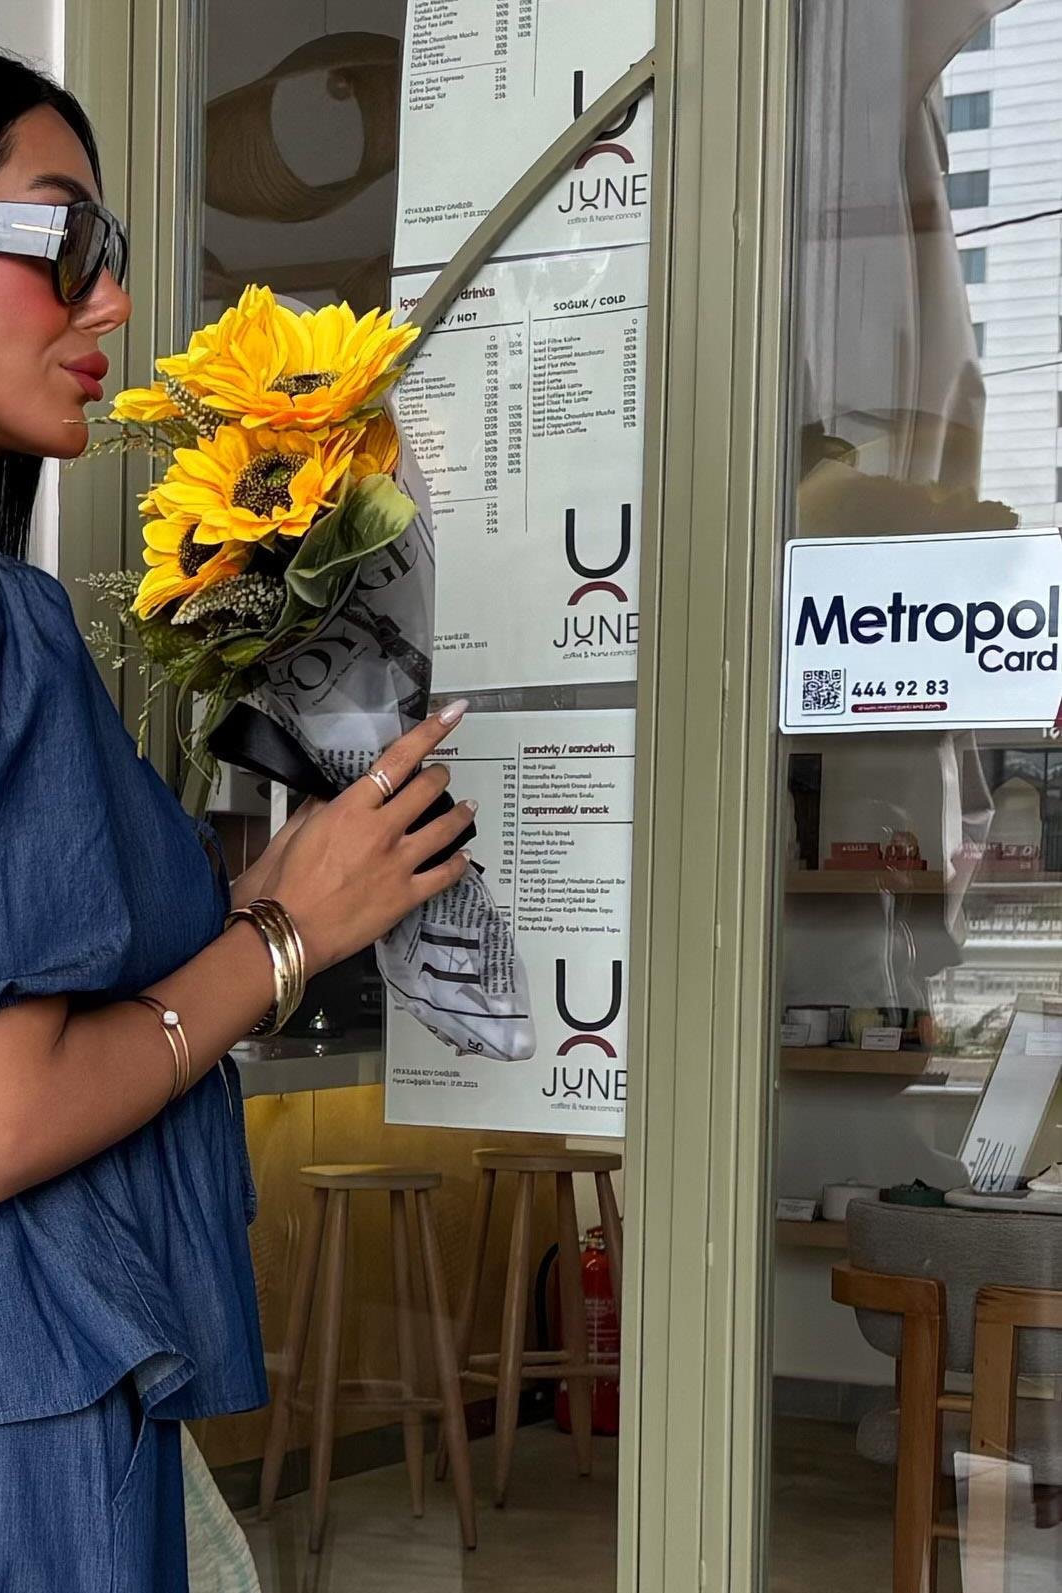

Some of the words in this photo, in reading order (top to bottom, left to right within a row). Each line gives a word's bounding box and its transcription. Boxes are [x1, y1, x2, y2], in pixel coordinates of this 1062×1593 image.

[558, 173, 648, 213] JUNE
[460, 287, 496, 300] drinks
[457, 312, 478, 323] HOT
[553, 300, 589, 311] SOĞUK
[599, 294, 626, 306] COLD
[553, 613, 639, 648] JUNE
[795, 585, 1060, 653] Metropol
[977, 643, 1058, 673] Card
[851, 682, 887, 698] 444
[894, 680, 919, 696] 92
[925, 679, 950, 696] 83
[523, 743, 561, 756] sandviç
[568, 742, 615, 754] sandwich
[580, 804, 610, 815] snack
[541, 1066, 628, 1101] JUNE
